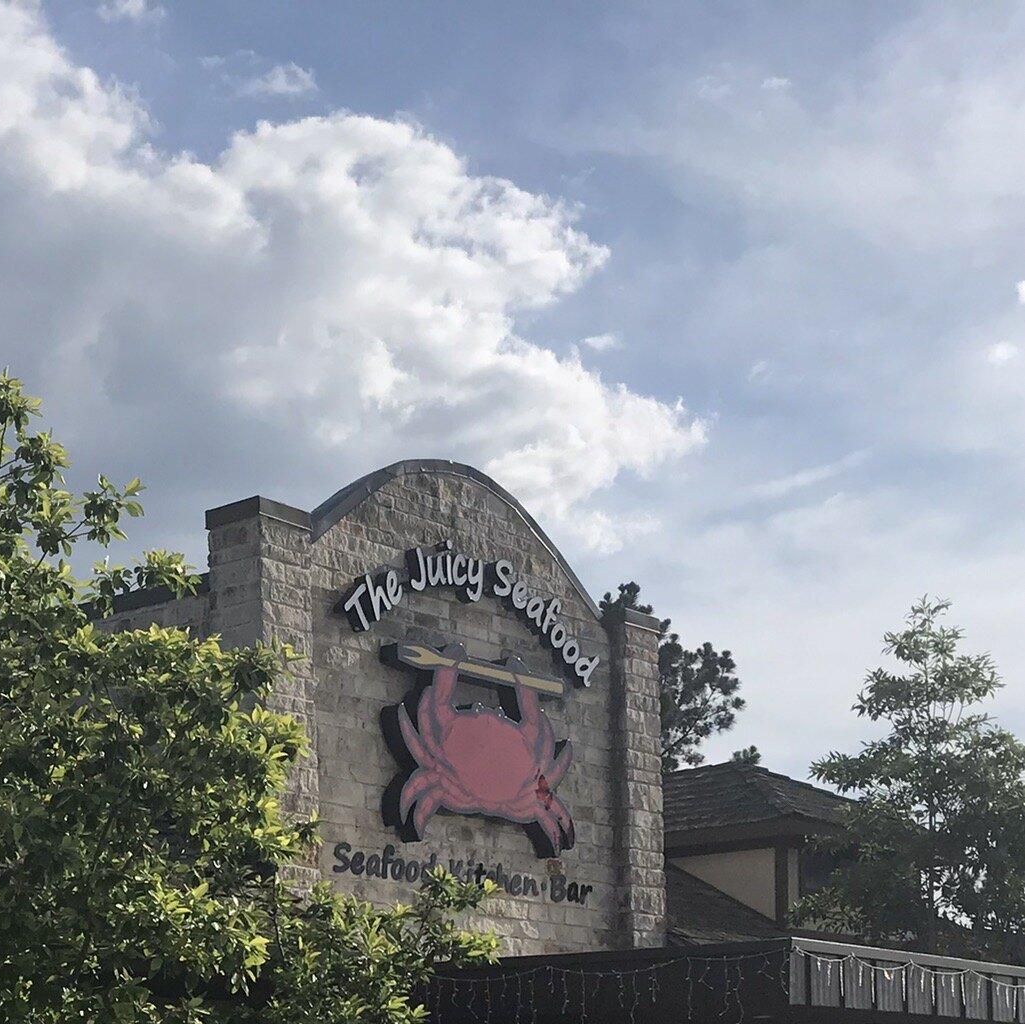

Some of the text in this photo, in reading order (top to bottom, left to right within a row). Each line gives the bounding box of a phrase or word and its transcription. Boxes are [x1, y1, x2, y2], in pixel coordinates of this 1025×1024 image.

[344, 539, 600, 687] The Juicy Seafood
[332, 841, 437, 884] Seafood
[549, 873, 593, 905] Bar
